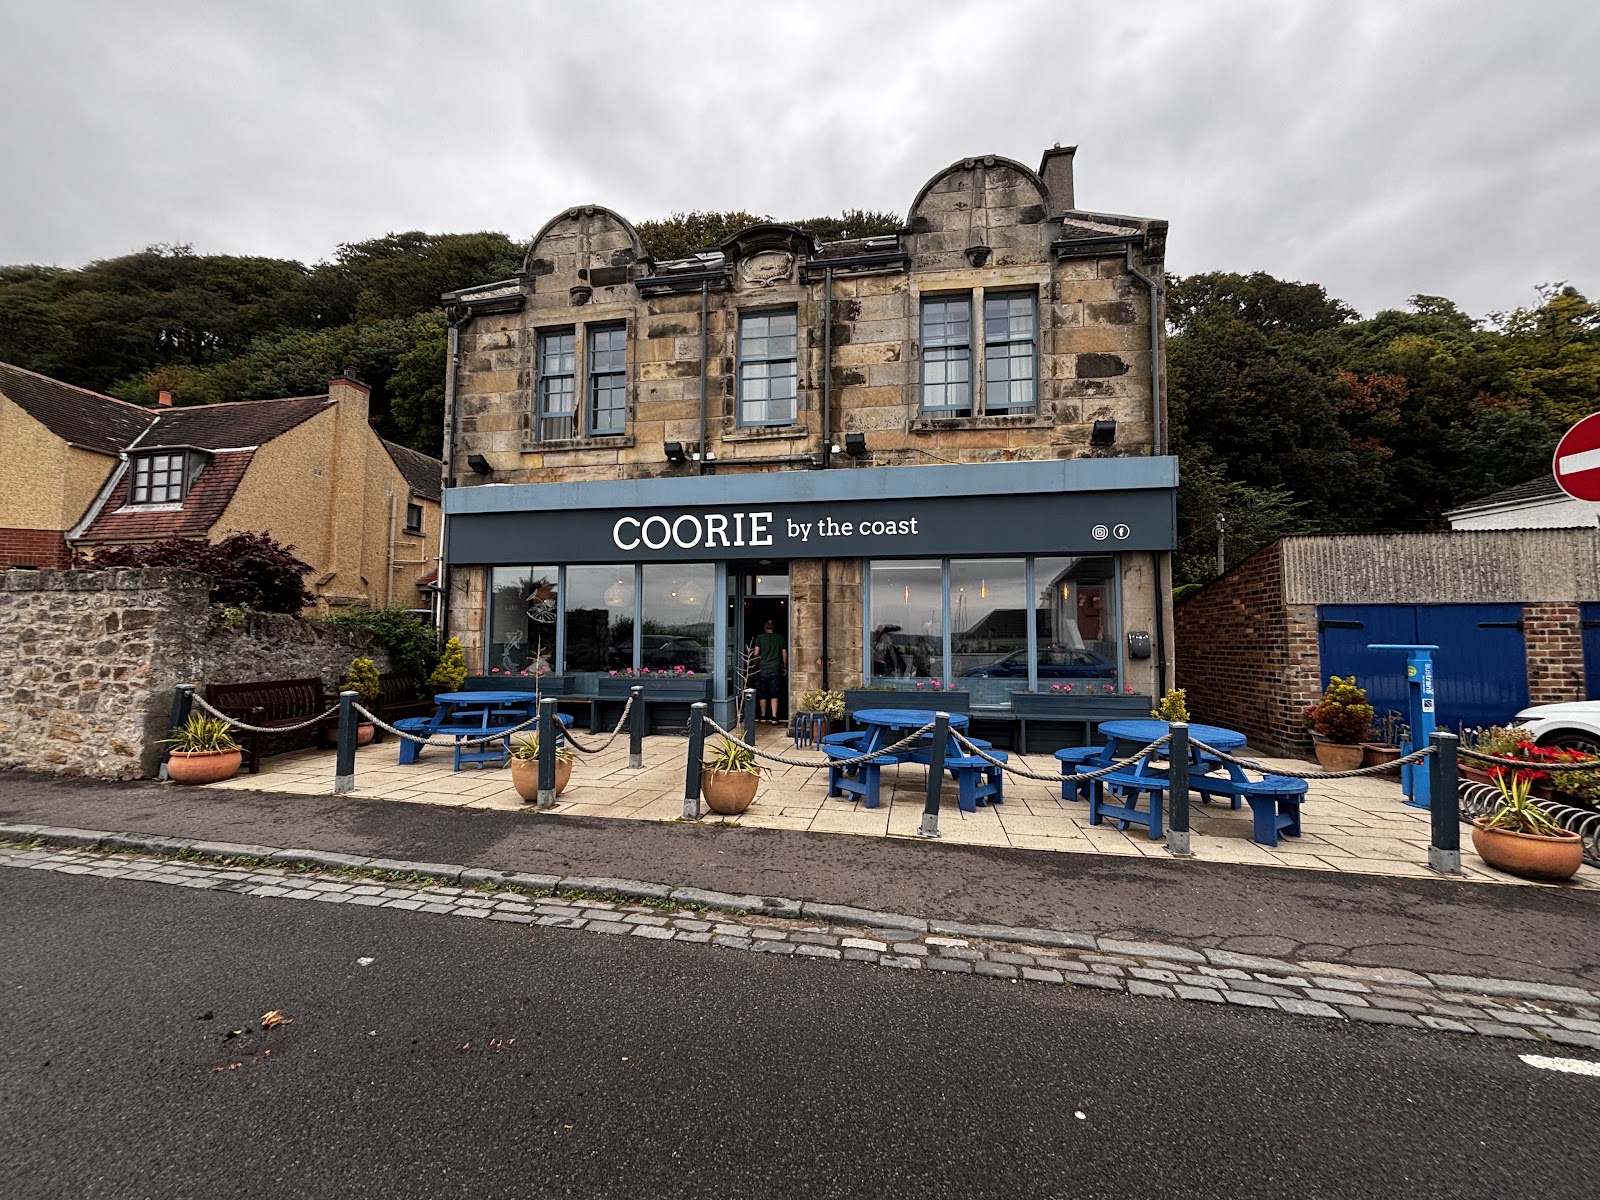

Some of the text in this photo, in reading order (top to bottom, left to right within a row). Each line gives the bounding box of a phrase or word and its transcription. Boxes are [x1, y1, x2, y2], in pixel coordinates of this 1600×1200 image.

[613, 512, 918, 550] COORIE by the coast
